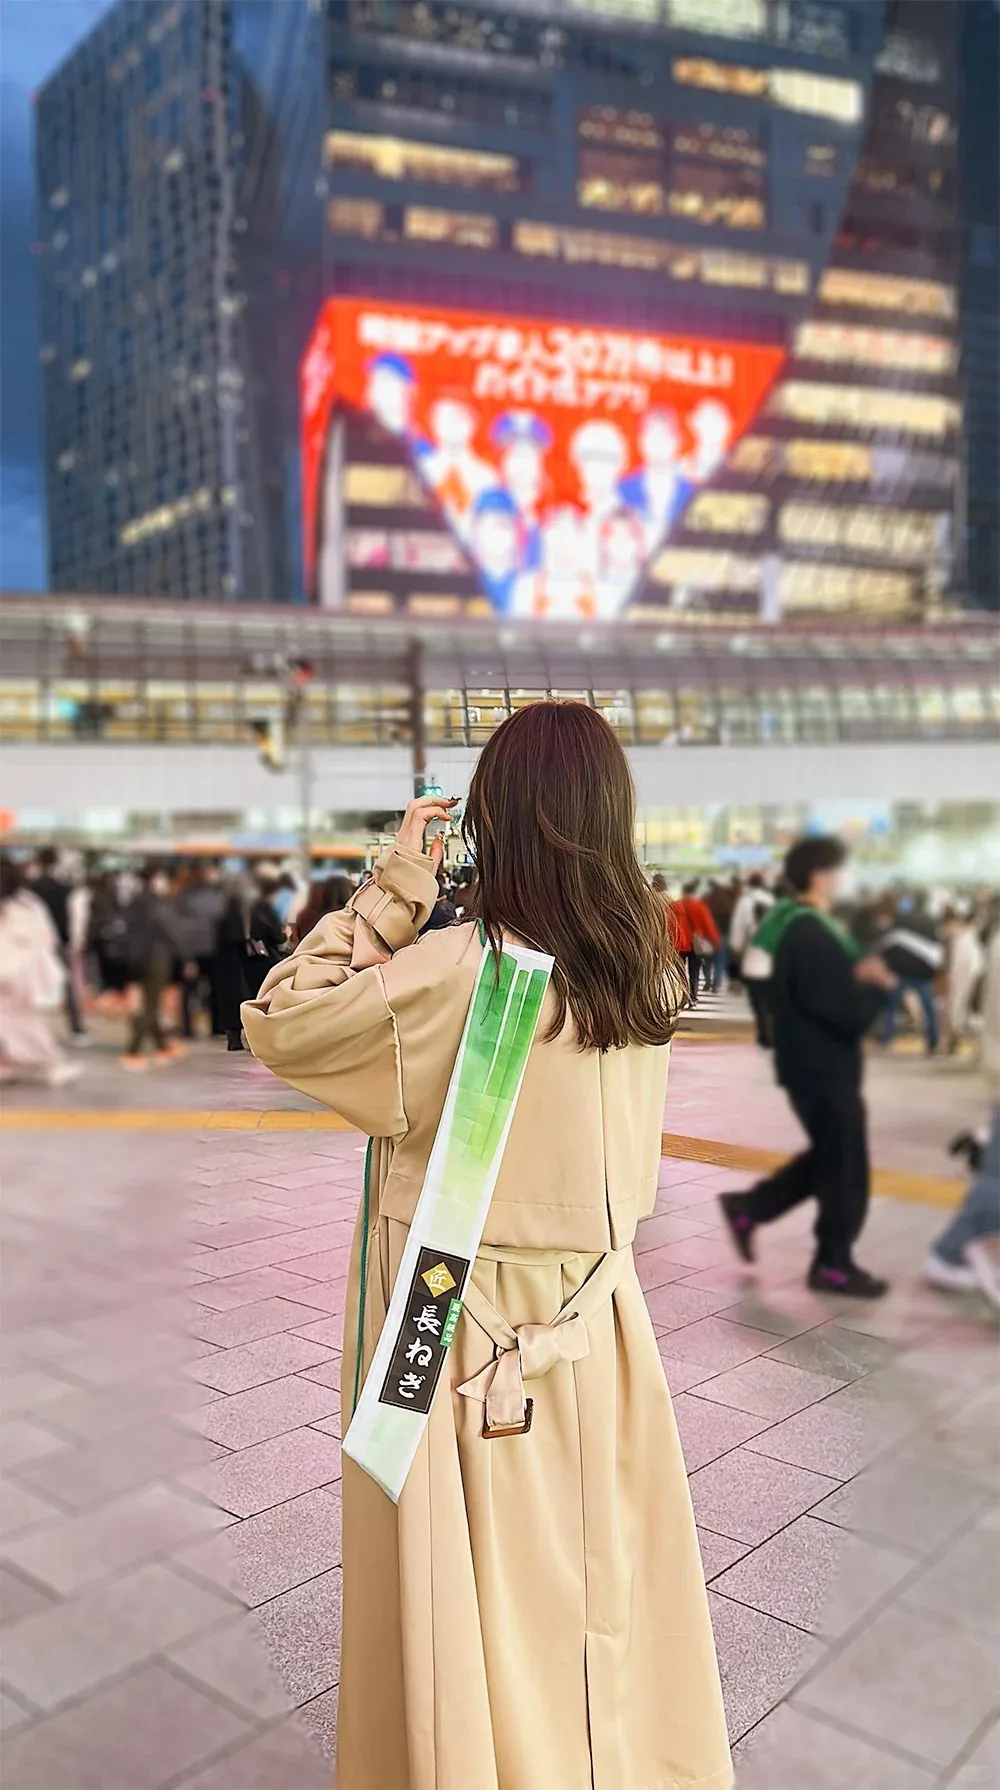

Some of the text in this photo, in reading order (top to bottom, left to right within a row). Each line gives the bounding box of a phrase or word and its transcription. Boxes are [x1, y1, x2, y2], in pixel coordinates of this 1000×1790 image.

[428, 1268, 447, 1292] 匠
[397, 1304, 442, 1399] 長ねぎ
